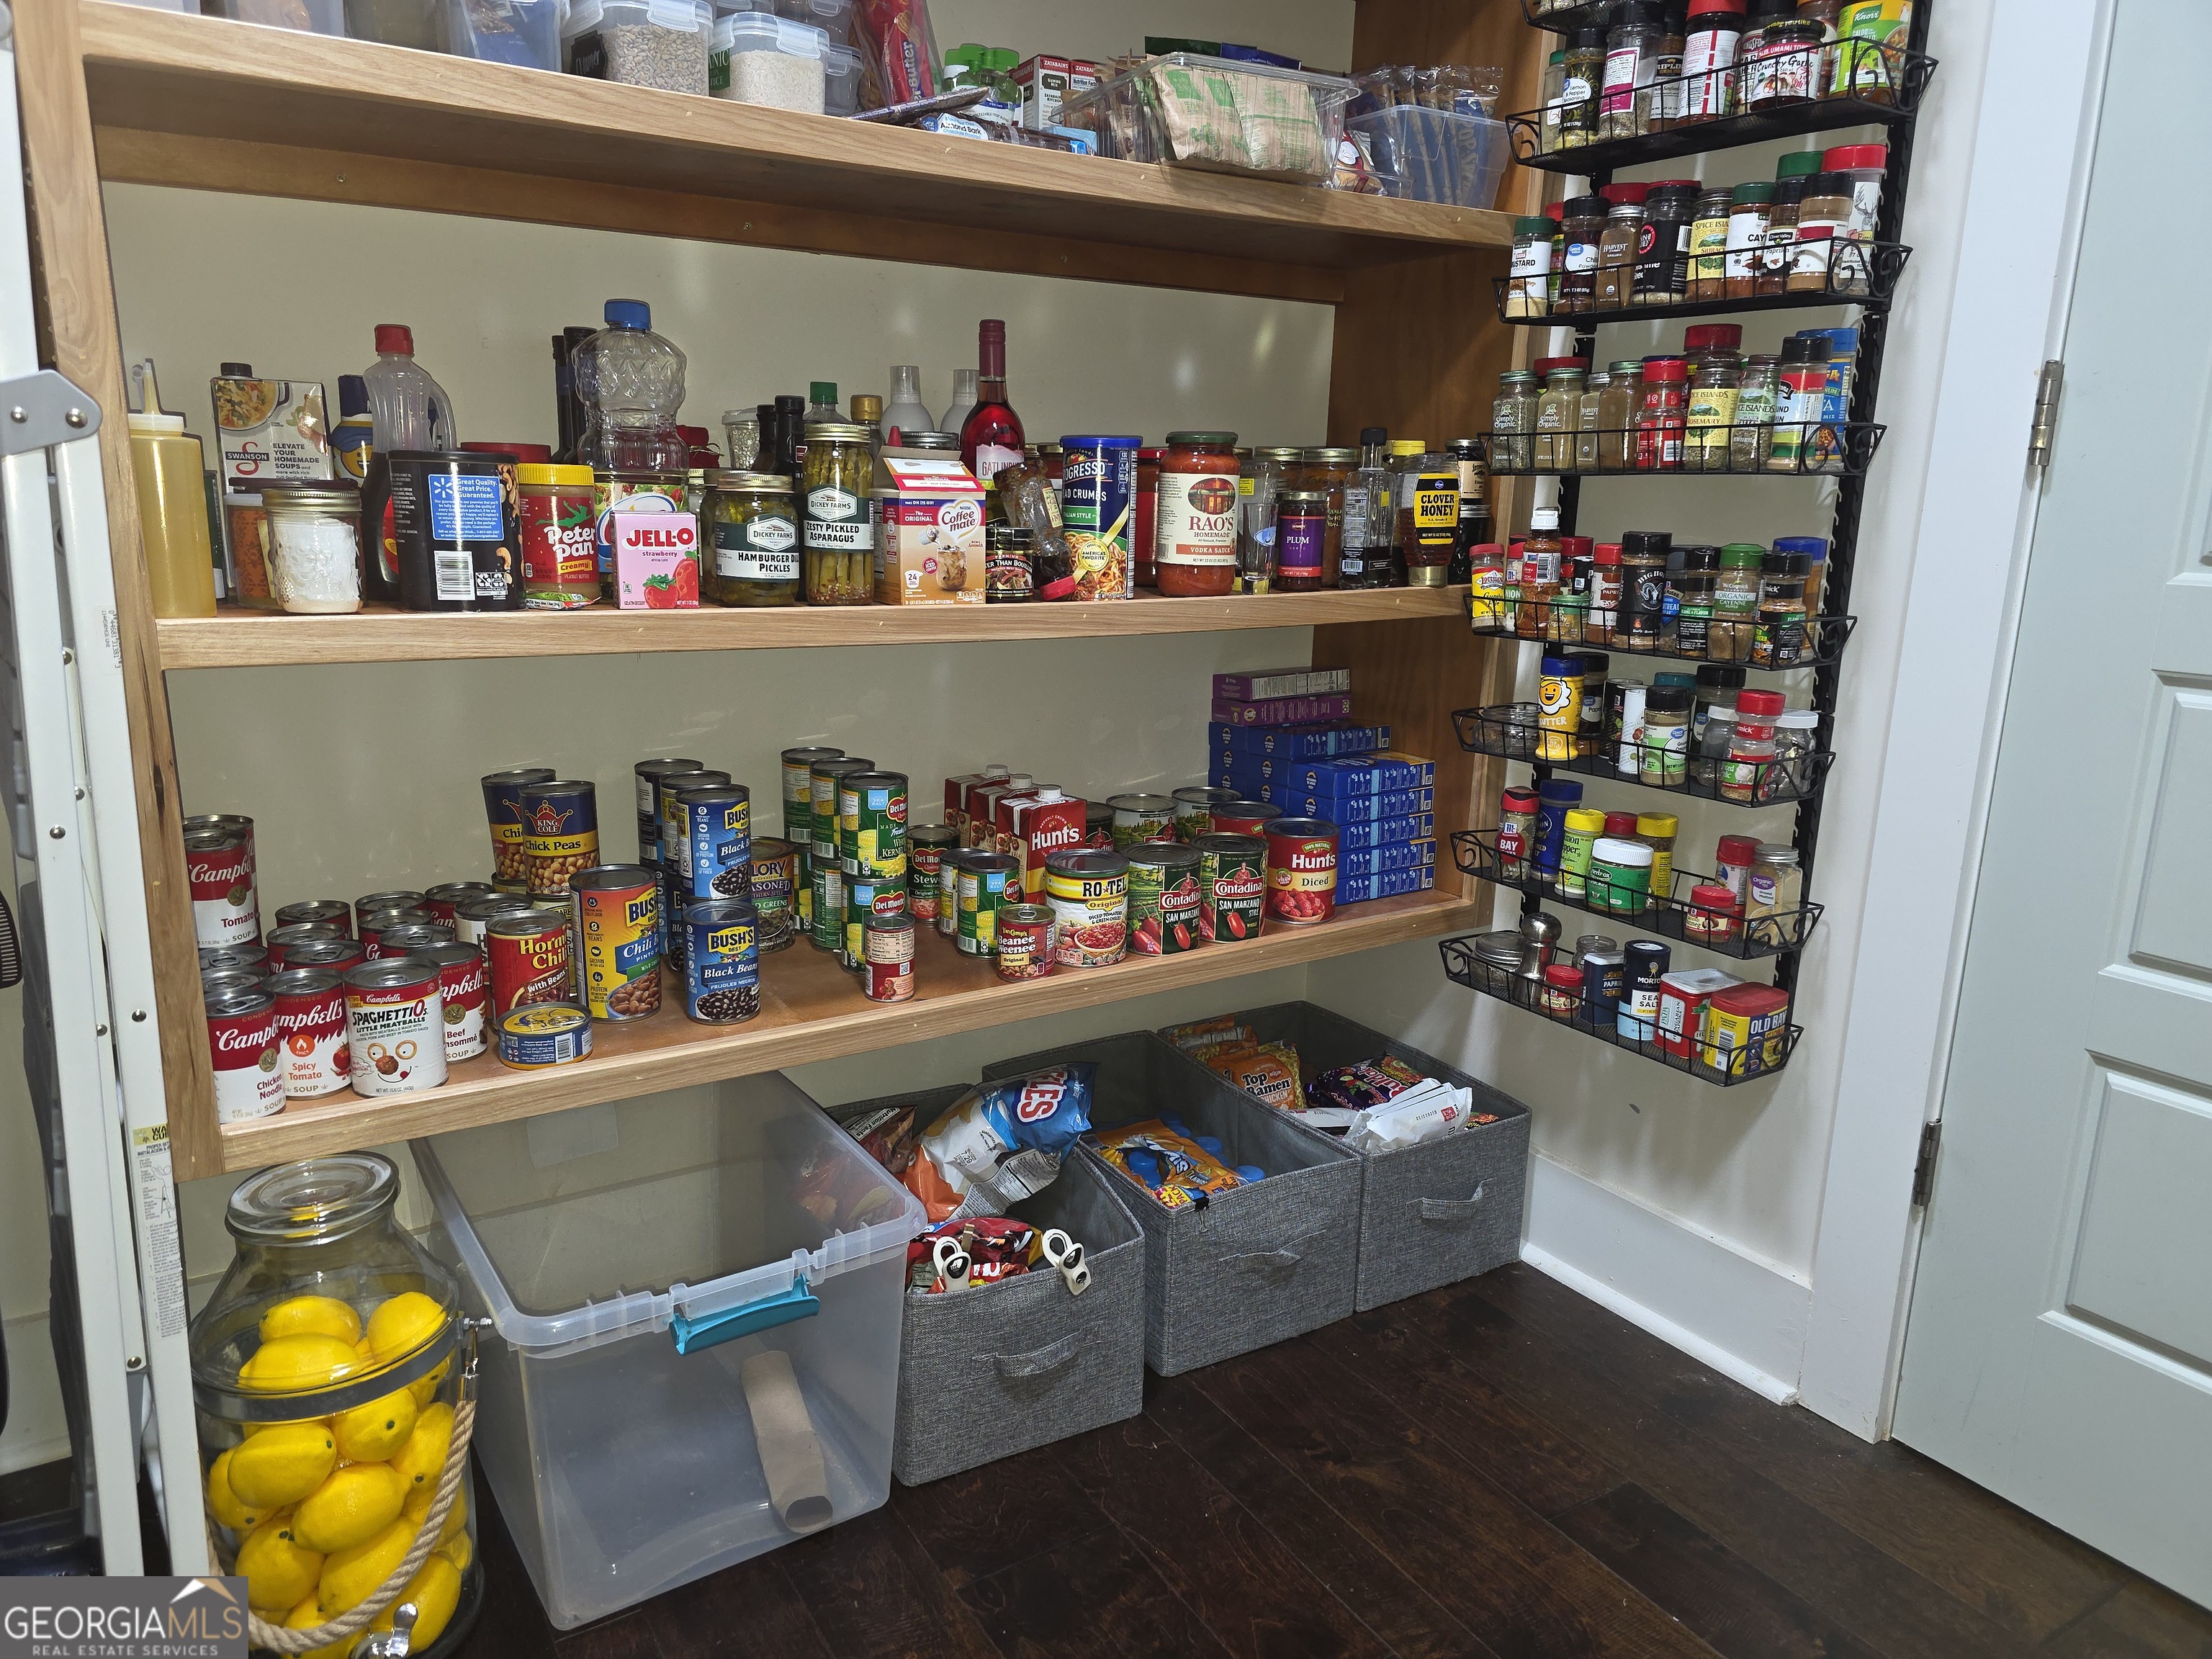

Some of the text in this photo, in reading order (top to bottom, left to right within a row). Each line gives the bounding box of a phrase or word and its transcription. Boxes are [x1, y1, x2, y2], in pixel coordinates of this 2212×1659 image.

[1853, 9, 1880, 22] Knorr
[1604, 243, 1628, 252] HARVEST
[1745, 404, 1776, 413] ISLANDS
[1073, 489, 1107, 501] CRUMBS
[1421, 495, 1455, 503] CLOVER
[1421, 505, 1454, 516] HONEY
[941, 511, 974, 523] Coffee
[806, 522, 860, 533] ZESTY PICKLED
[950, 518, 976, 532] mate
[1189, 516, 1233, 531] RAO'S
[544, 526, 595, 544] Peter
[810, 532, 855, 543] ASPARAGUS
[1287, 536, 1310, 544] PLUM
[552, 540, 594, 563] Pan
[738, 552, 789, 562] HAMBURGER
[561, 562, 589, 571] Creamy
[759, 562, 791, 572] PICKLES
[1539, 716, 1567, 726] BUTTER
[890, 804, 899, 814] Del
[525, 840, 581, 851] Chick Peas
[721, 842, 745, 857] Black
[1501, 839, 1518, 851] BAY
[914, 854, 927, 863] Del
[1301, 876, 1328, 887] Diced
[1753, 877, 1772, 886] Organic
[1215, 881, 1263, 896] Contadina
[763, 900, 788, 909] GREENS
[876, 901, 887, 909] Del
[1089, 898, 1123, 909] Original
[1219, 898, 1259, 910] SAN MARZANO
[1166, 912, 1182, 923] SAN
[1248, 908, 1259, 917] STYLE
[221, 912, 253, 928] Tomato
[232, 932, 251, 942] SOUP
[1010, 927, 1028, 936] Camp's
[711, 929, 754, 950] BUSH'S
[998, 935, 1035, 945] Beanee
[624, 938, 652, 958] Chili
[998, 943, 1035, 953] Weenee
[637, 950, 654, 962] PINTO
[642, 963, 650, 971] MILD
[704, 962, 758, 978] Black Beans
[548, 969, 565, 985] Beans
[711, 981, 737, 990] FRIJOLES
[367, 994, 401, 1004] Campbell's
[379, 1017, 426, 1030] MEATBALLS
[1750, 1010, 1787, 1034] OLD BAY
[447, 1028, 466, 1038] Beef
[447, 1049, 469, 1059] SOUP
[292, 1063, 316, 1071] Spicy
[257, 1074, 282, 1090] Chicken
[1242, 1073, 1267, 1086] Top
[260, 1084, 282, 1100] Noodle
[1246, 1079, 1290, 1096] Ramen
[264, 1098, 282, 1112] SOUP
[855, 1107, 899, 1141] Nutrition Facts
